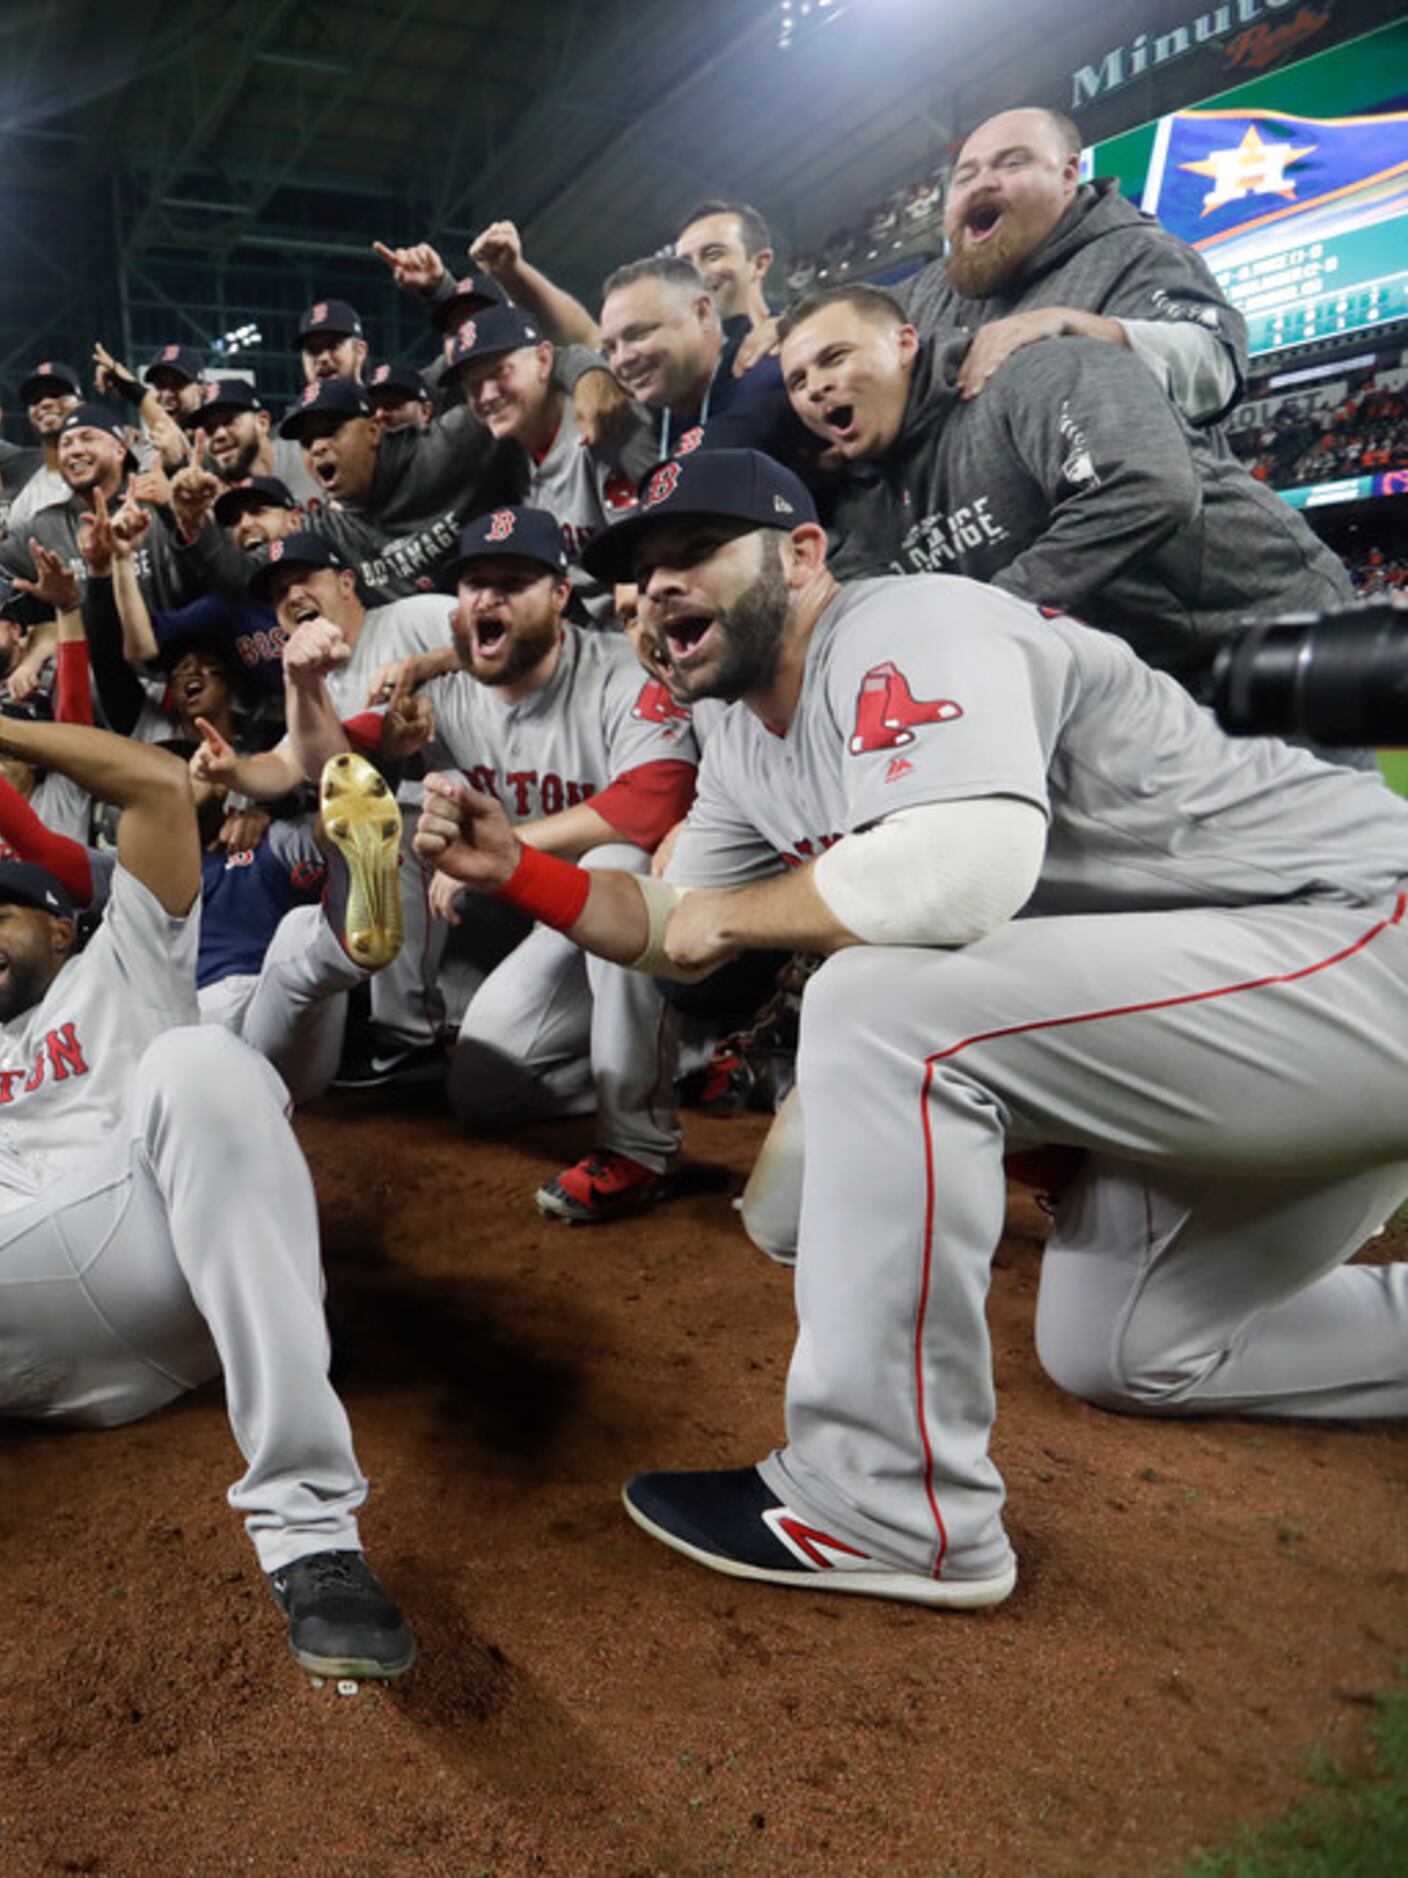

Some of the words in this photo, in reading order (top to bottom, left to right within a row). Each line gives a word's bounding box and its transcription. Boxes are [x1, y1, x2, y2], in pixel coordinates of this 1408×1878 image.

[459, 320, 477, 351] B
[642, 462, 681, 509] B
[484, 509, 516, 541] B
